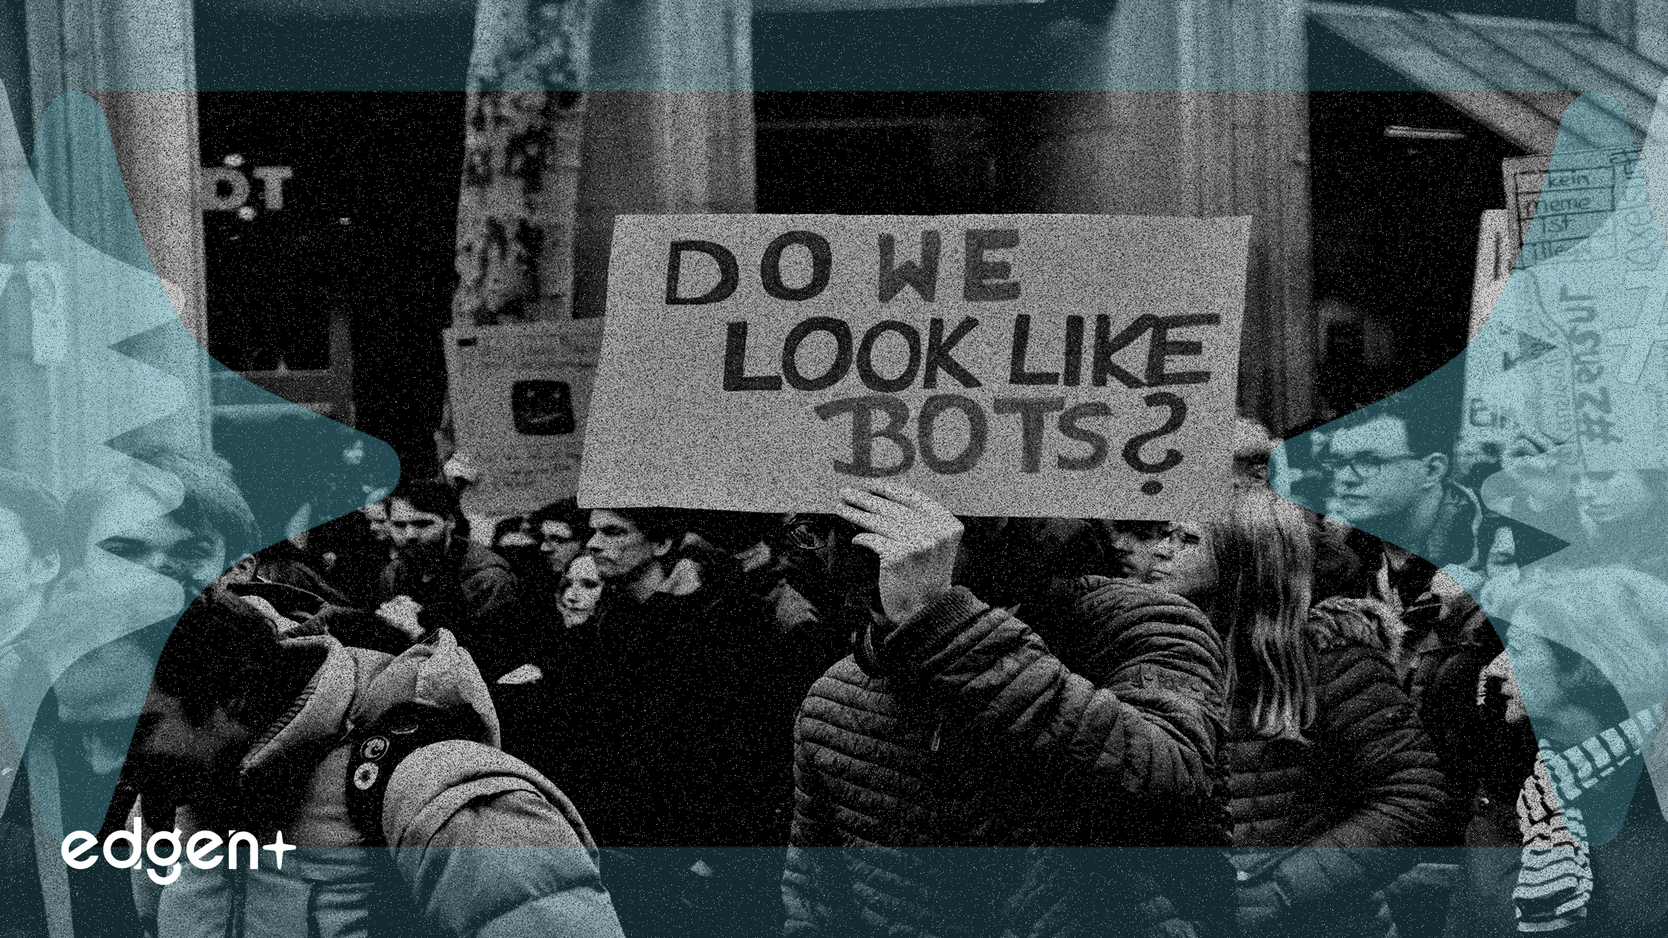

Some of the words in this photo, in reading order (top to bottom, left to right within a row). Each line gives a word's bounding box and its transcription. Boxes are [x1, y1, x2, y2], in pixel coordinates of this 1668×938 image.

[665, 230, 832, 305] DO
[878, 228, 1022, 302] WE
[723, 315, 983, 392] LOOK
[1008, 312, 1221, 390] LIKE
[814, 391, 1188, 496] BOTS?
